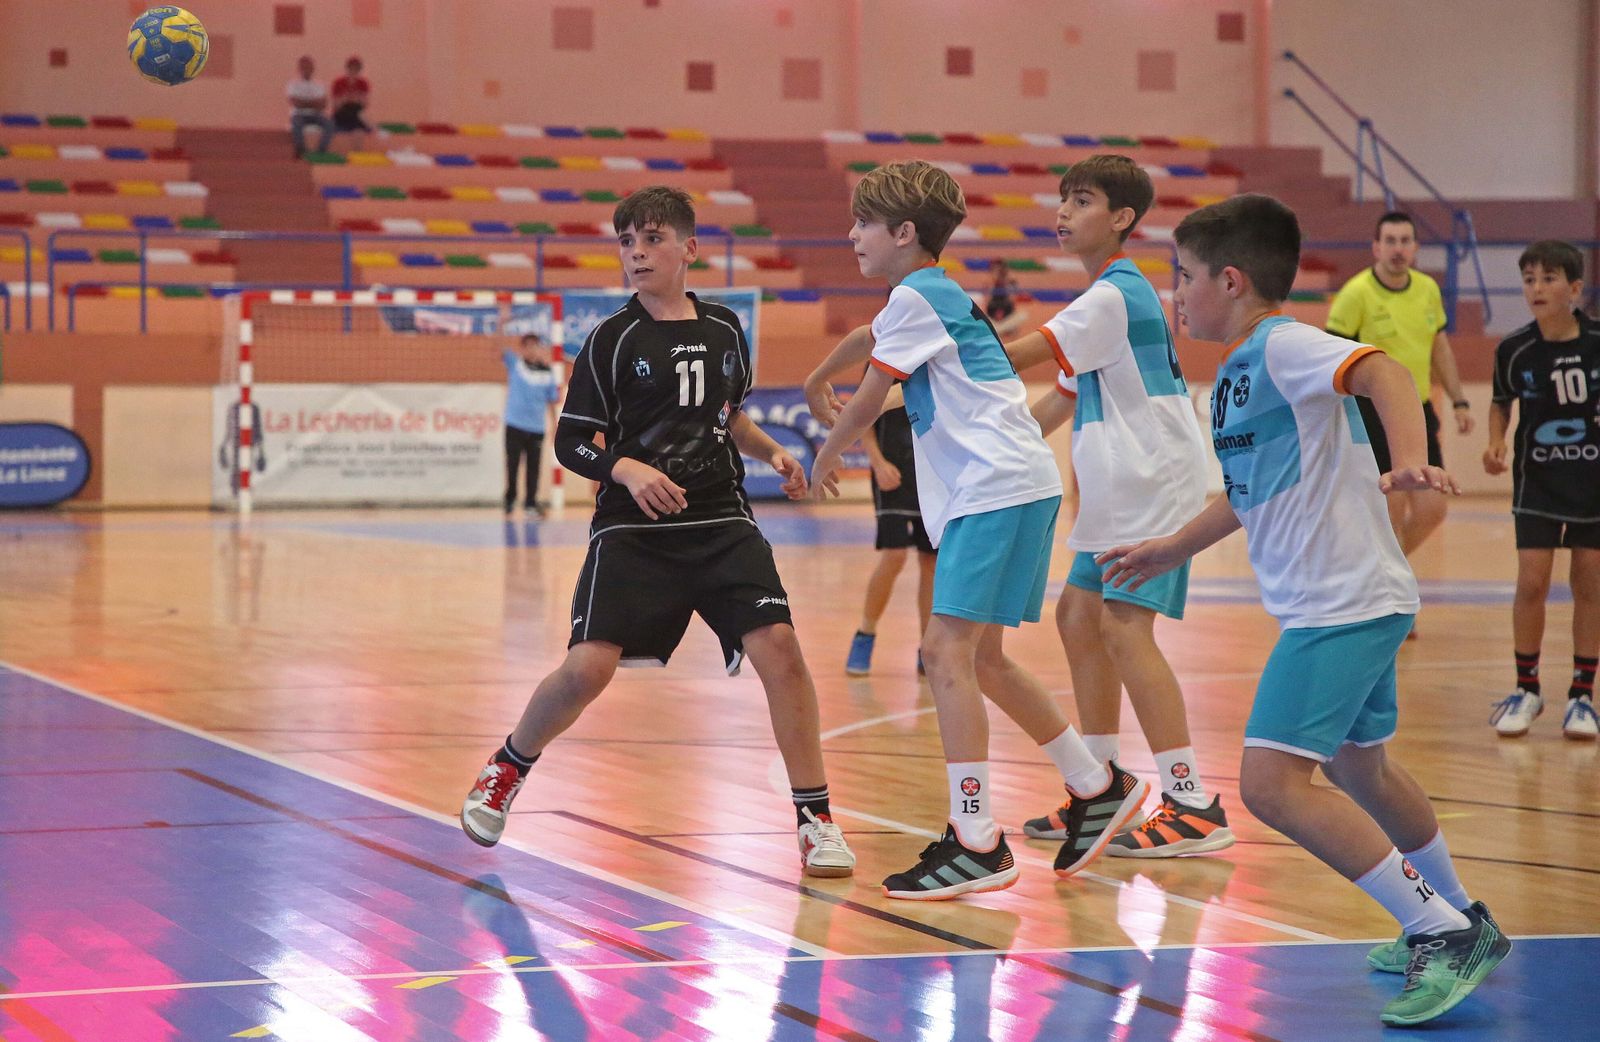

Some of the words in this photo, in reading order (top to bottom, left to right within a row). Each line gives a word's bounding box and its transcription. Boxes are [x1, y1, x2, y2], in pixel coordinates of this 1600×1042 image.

[675, 360, 705, 406] 11
[1550, 368, 1588, 405] 10
[264, 409, 291, 433] La
[399, 409, 427, 433] de
[433, 408, 500, 440] Diego
[1172, 780, 1195, 792] 40
[961, 799, 980, 814] 15
[1415, 879, 1434, 904] 10
